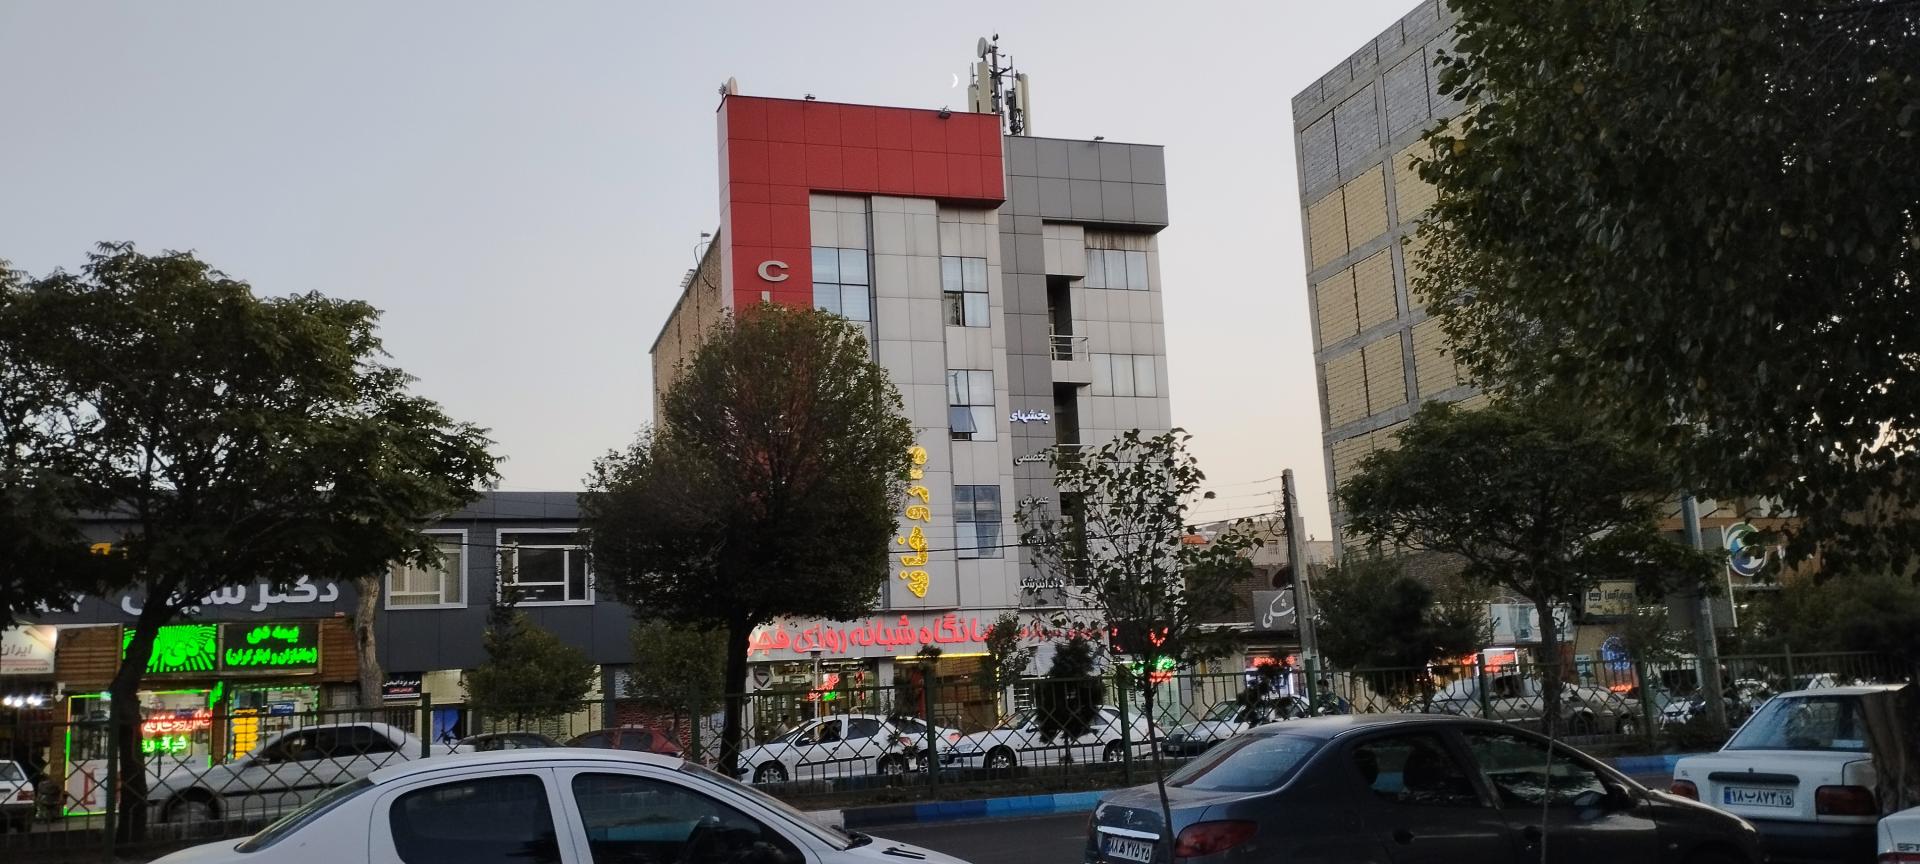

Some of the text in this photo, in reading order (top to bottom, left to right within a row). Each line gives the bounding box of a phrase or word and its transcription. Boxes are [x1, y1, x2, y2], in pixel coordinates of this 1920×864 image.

[1009, 409, 1050, 424] بخشهای
[251, 575, 339, 612] دکتر
[247, 626, 299, 644] بیمه دی
[793, 624, 847, 654] روزی
[850, 614, 917, 652] شبانه
